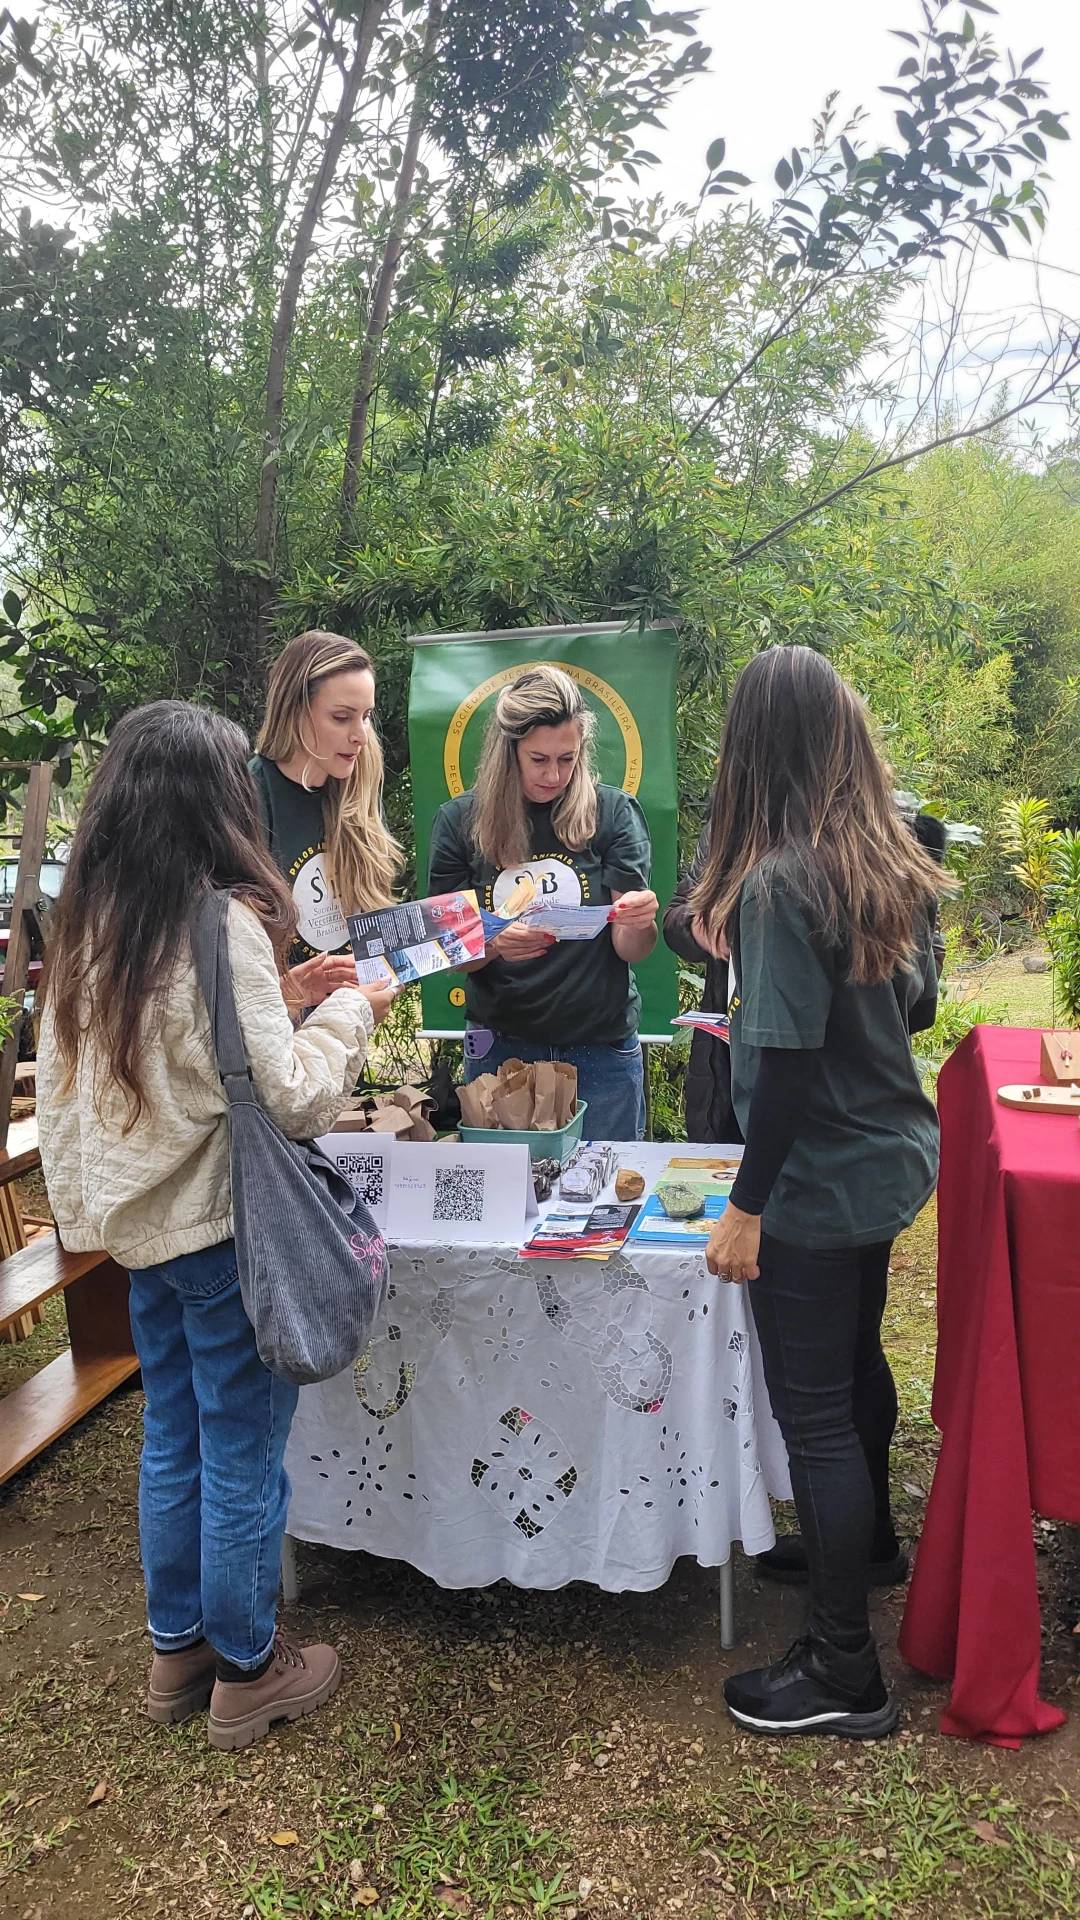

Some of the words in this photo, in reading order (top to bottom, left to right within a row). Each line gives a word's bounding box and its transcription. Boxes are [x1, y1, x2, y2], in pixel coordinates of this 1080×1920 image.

[452, 682, 497, 736] SOCIEDADE
[584, 676, 632, 733] BRASILEIRA
[449, 765, 461, 794] PELO
[627, 758, 638, 790] NETA
[289, 846, 314, 876] PELOS
[532, 853, 574, 865] ANIMAIS
[484, 885, 492, 911] SOAS
[579, 873, 590, 899] PELO
